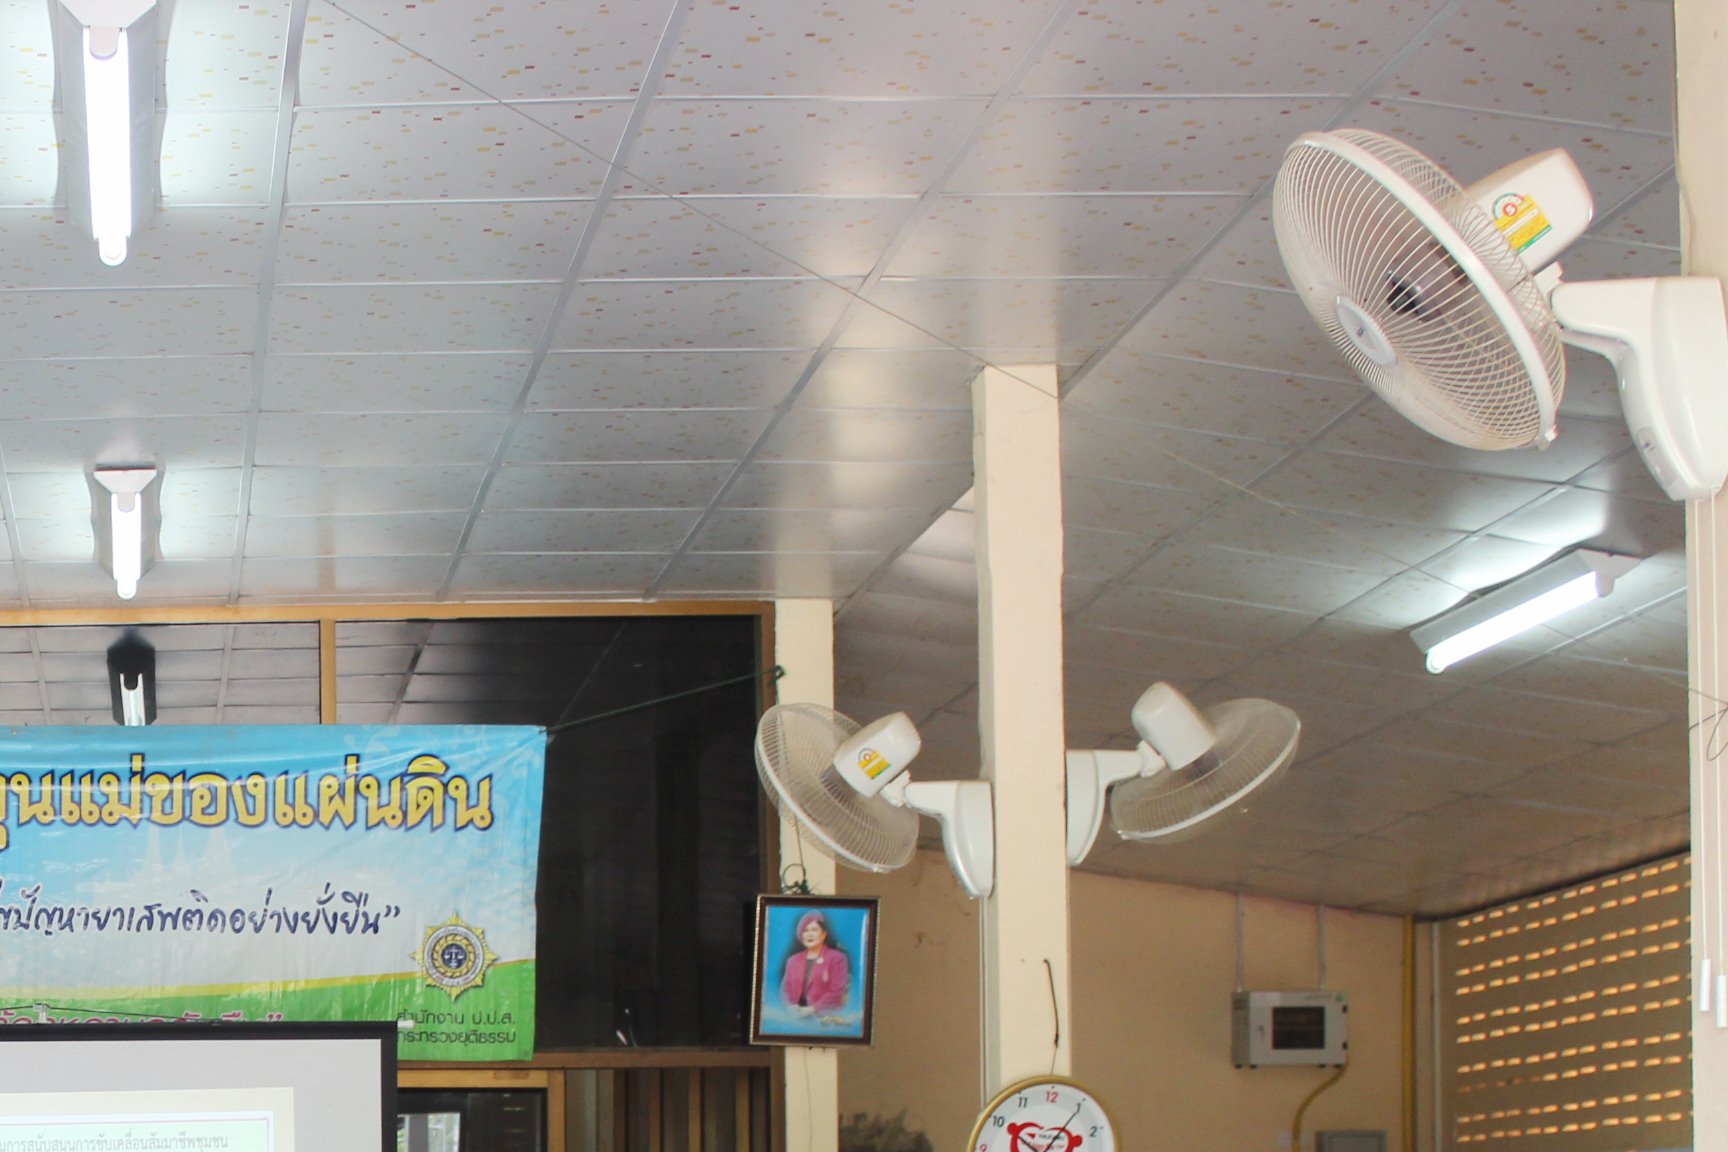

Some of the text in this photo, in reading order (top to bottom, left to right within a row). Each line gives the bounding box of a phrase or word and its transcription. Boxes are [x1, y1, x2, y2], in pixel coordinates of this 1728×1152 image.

[472, 1010, 516, 1025] ป.ป.ส.
[1018, 1097, 1029, 1108] 11
[1045, 1091, 1059, 1103] 12
[1075, 1102, 1082, 1113] 1
[992, 1114, 1005, 1128] 10
[1089, 1126, 1099, 1138] 2
